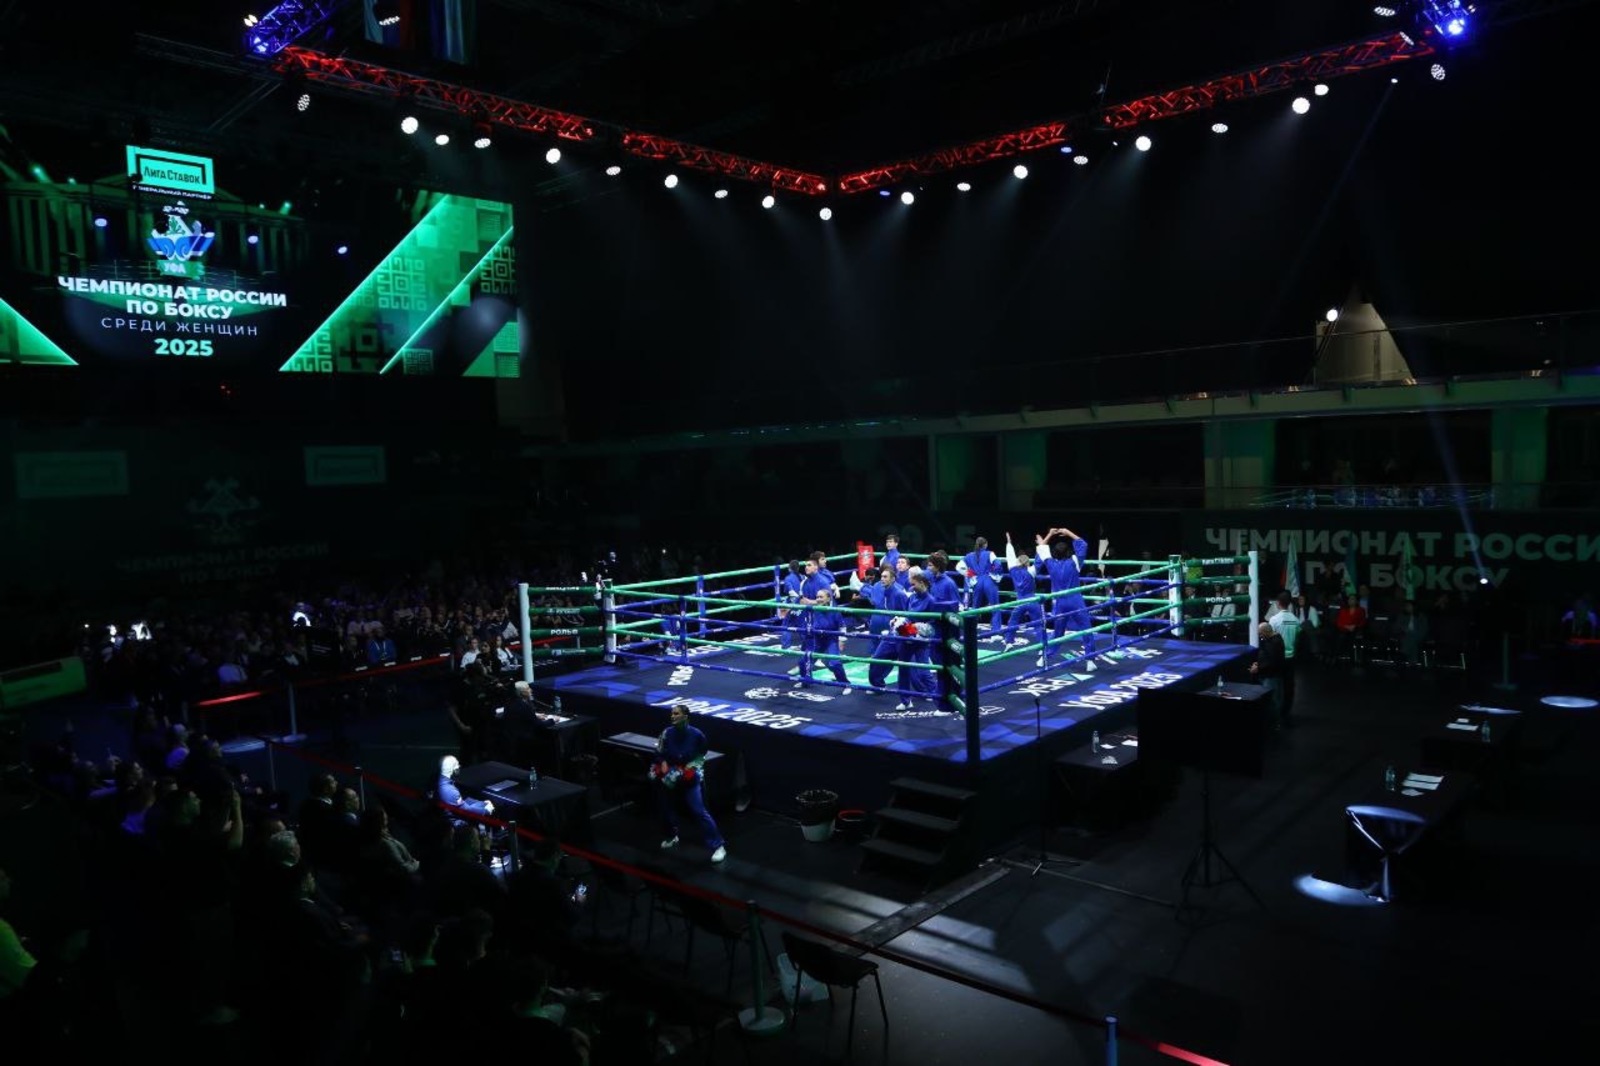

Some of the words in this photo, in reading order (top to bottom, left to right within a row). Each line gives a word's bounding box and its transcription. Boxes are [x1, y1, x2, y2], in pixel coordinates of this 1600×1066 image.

[164, 261, 186, 274] УФА
[57, 275, 202, 301] ЧЕМПИОНАТ
[206, 287, 287, 307] РОССИИ
[126, 299, 158, 315] ПО
[164, 303, 233, 320] БОКСУ
[101, 317, 166, 332] СРЕДИ
[176, 321, 258, 337] ЖЕНЩИН
[154, 338, 213, 357] 2025
[1205, 528, 1442, 557] ЧЕМПИОНАТ
[1109, 672, 1183, 691] 2025
[712, 707, 813, 730] 2025
